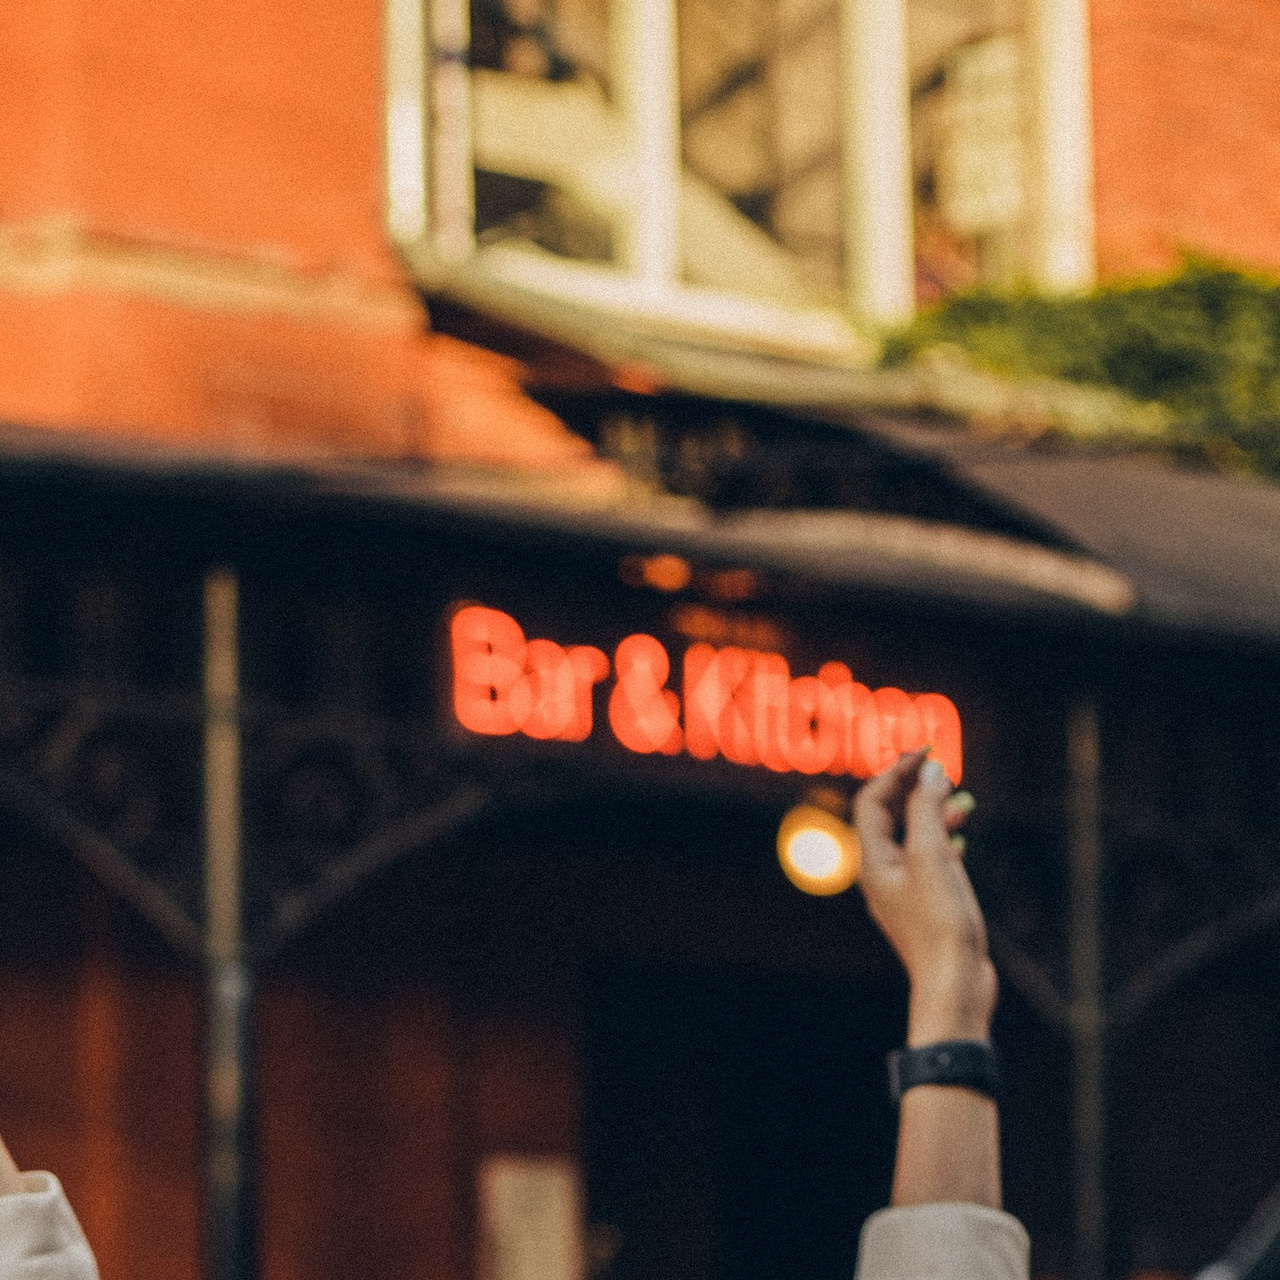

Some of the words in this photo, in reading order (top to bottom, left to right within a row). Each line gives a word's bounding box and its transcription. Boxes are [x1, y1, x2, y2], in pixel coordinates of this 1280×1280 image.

[451, 606, 609, 742] Bar
[609, 633, 682, 756] &
[683, 642, 963, 787] Kitchen
